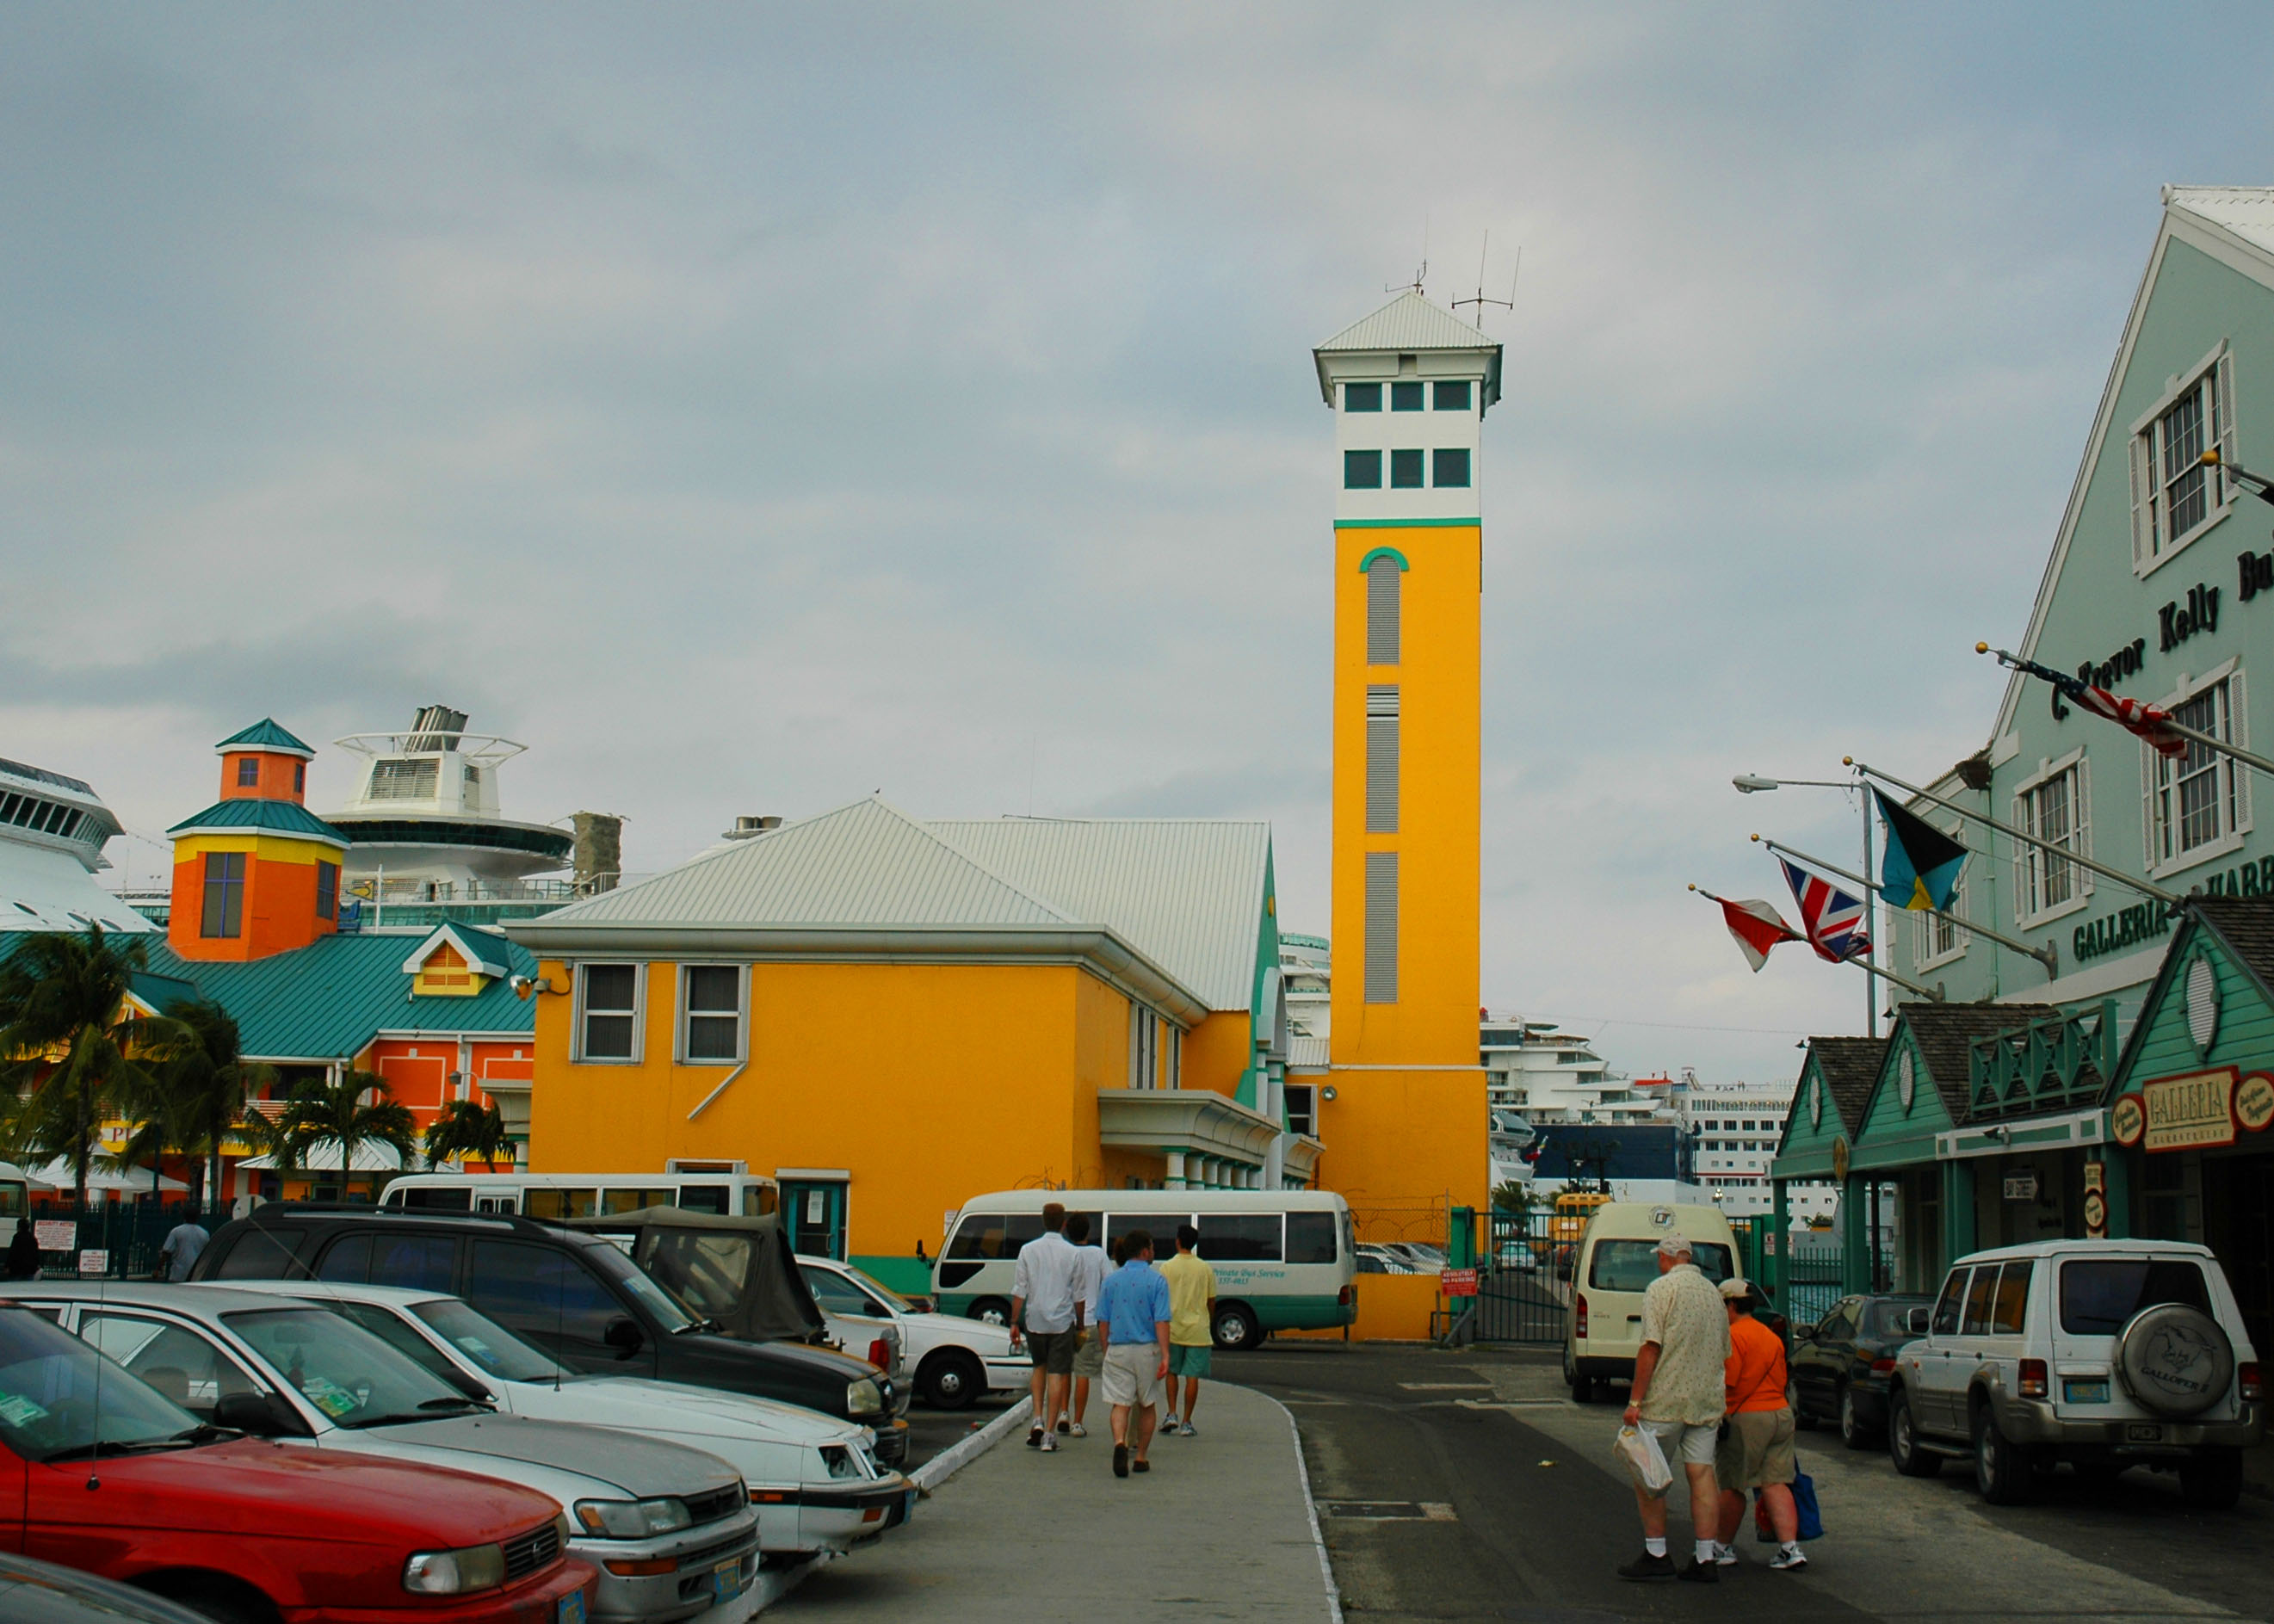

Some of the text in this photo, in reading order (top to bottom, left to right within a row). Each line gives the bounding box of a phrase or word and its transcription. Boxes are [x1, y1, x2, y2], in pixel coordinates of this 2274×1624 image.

[2158, 583, 2219, 652] Kelly
[2237, 529, 2274, 602] Bu
[2073, 898, 2170, 962] GALLERIA
[2150, 1080, 2225, 1125] GALLERIA
[1257, 1268, 1285, 1279] Service
[2141, 1367, 2199, 1391] GALLOPER
